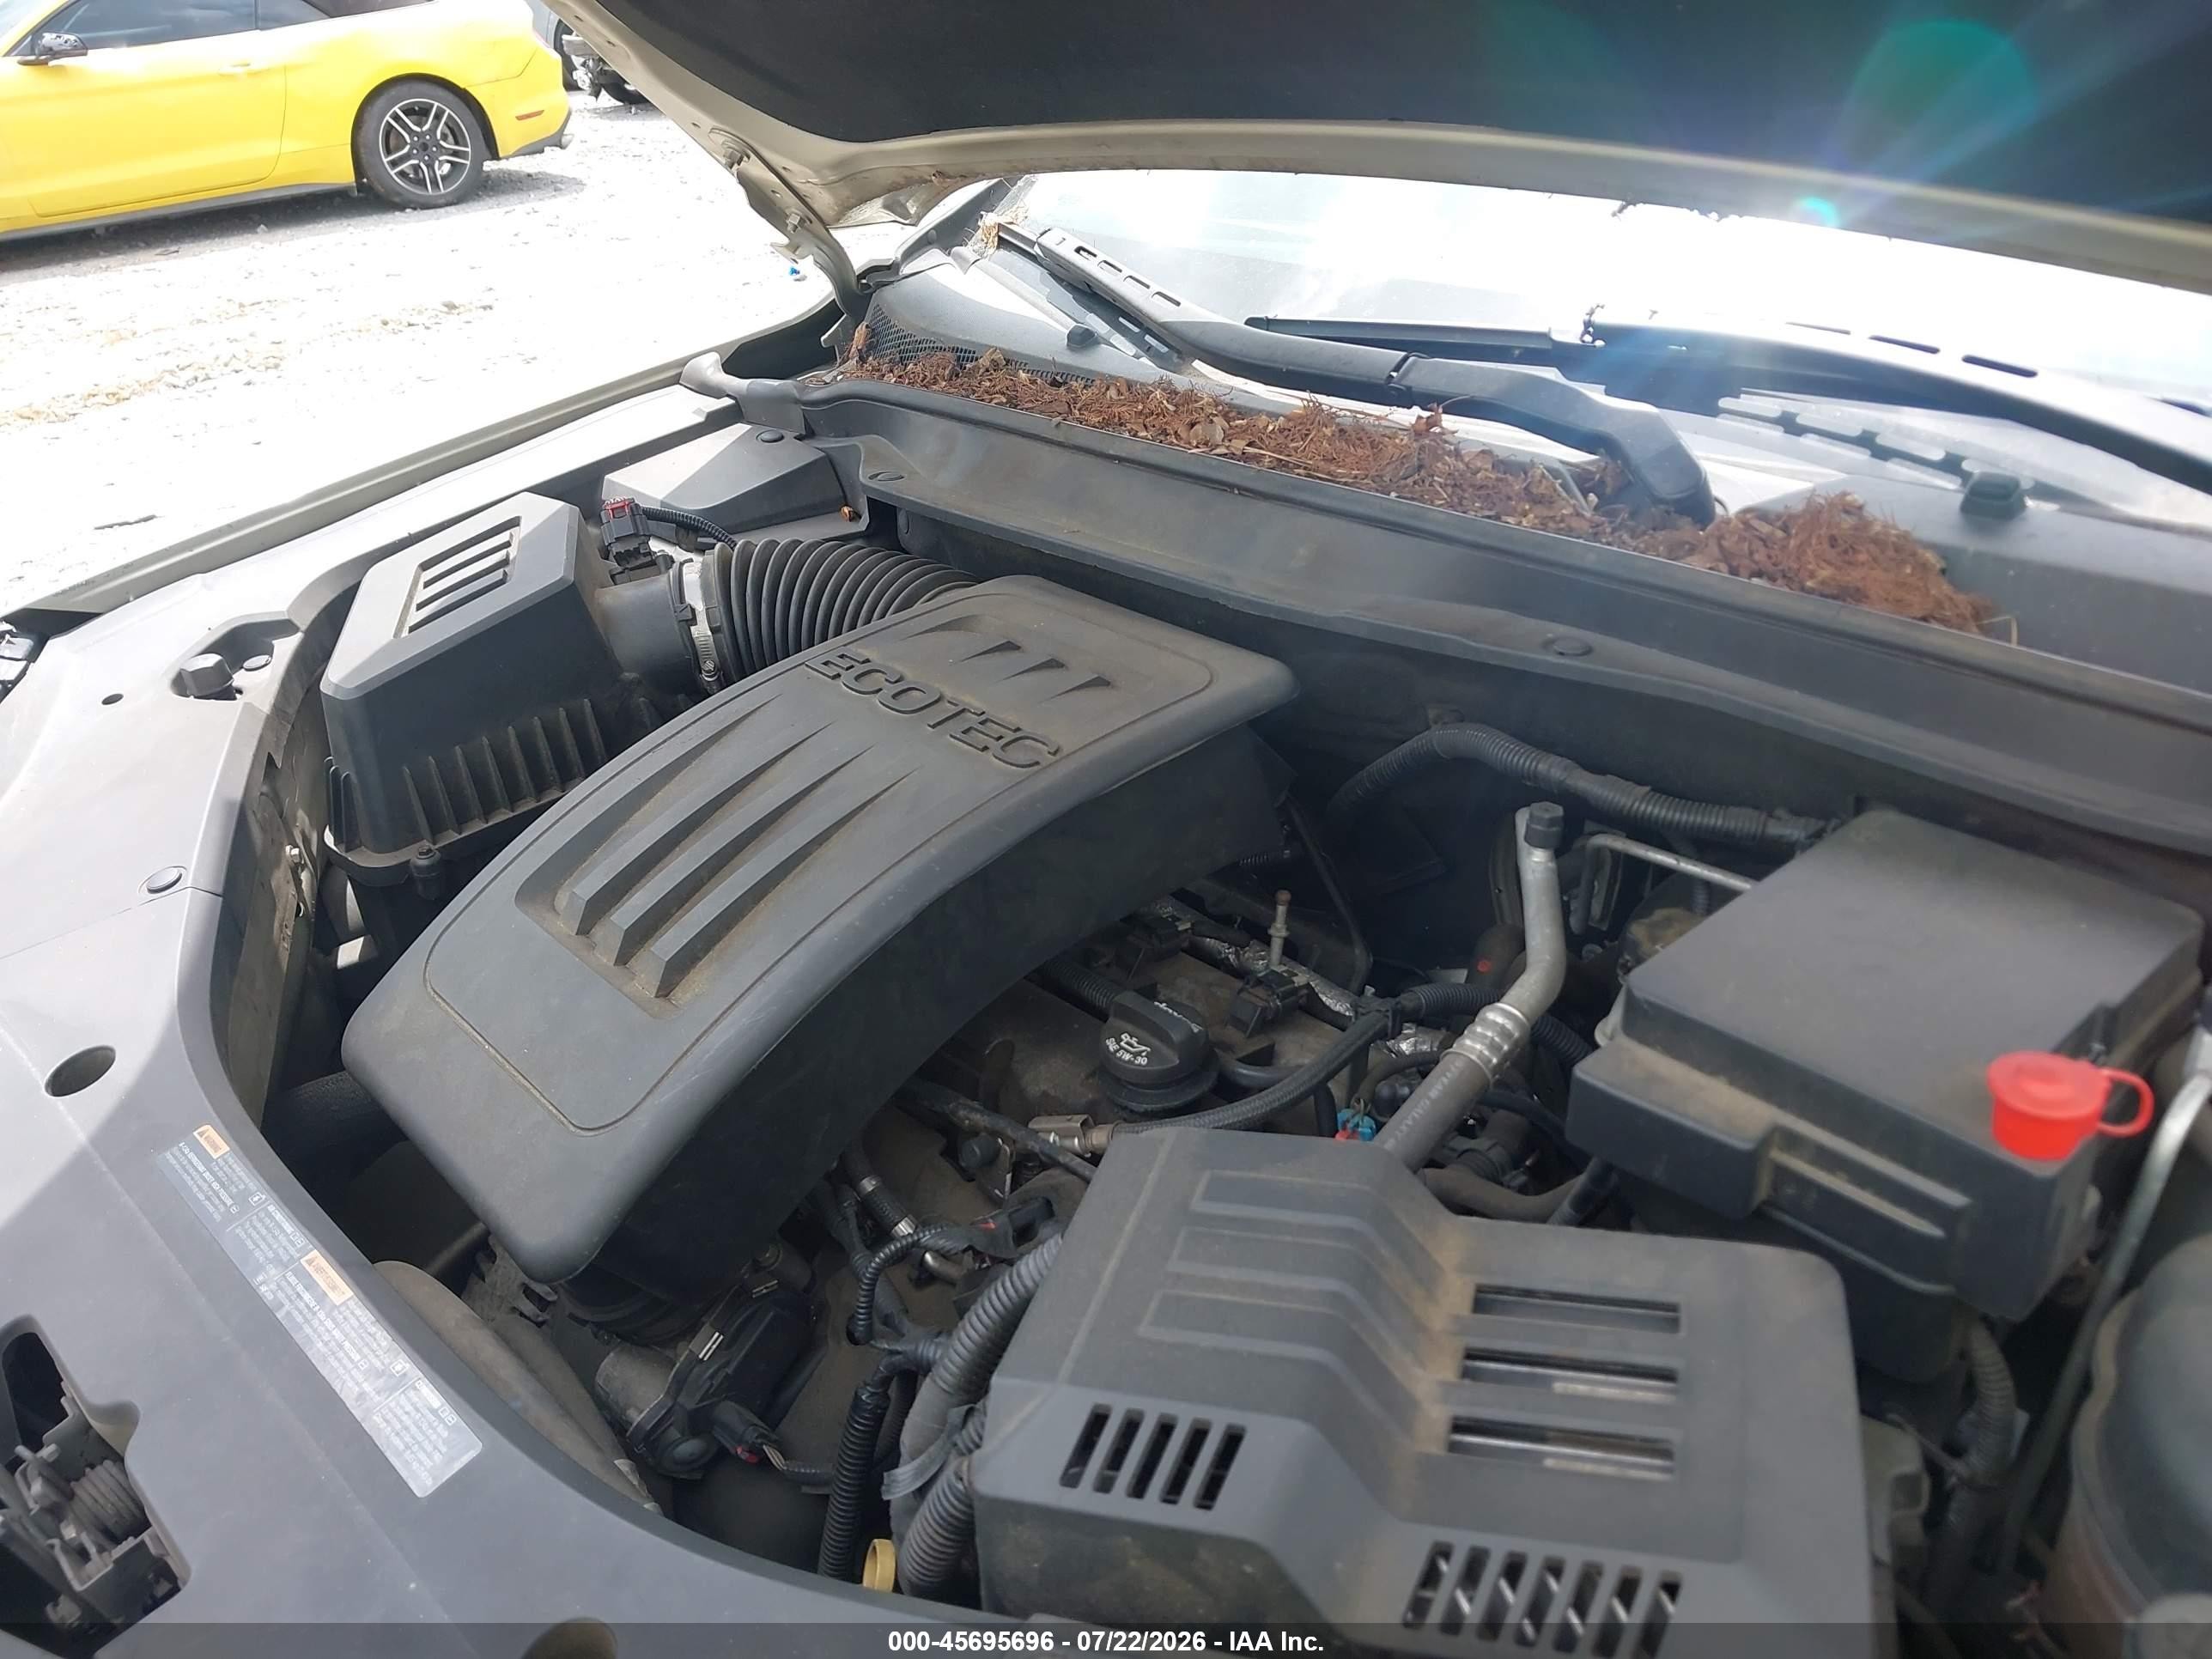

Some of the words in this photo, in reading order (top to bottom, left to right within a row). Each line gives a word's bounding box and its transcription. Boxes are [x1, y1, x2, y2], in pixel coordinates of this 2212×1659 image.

[805, 648, 1061, 769] ECOTEC
[1105, 1036, 1121, 1053] SAE
[1116, 1048, 1148, 1066] 5W-30
